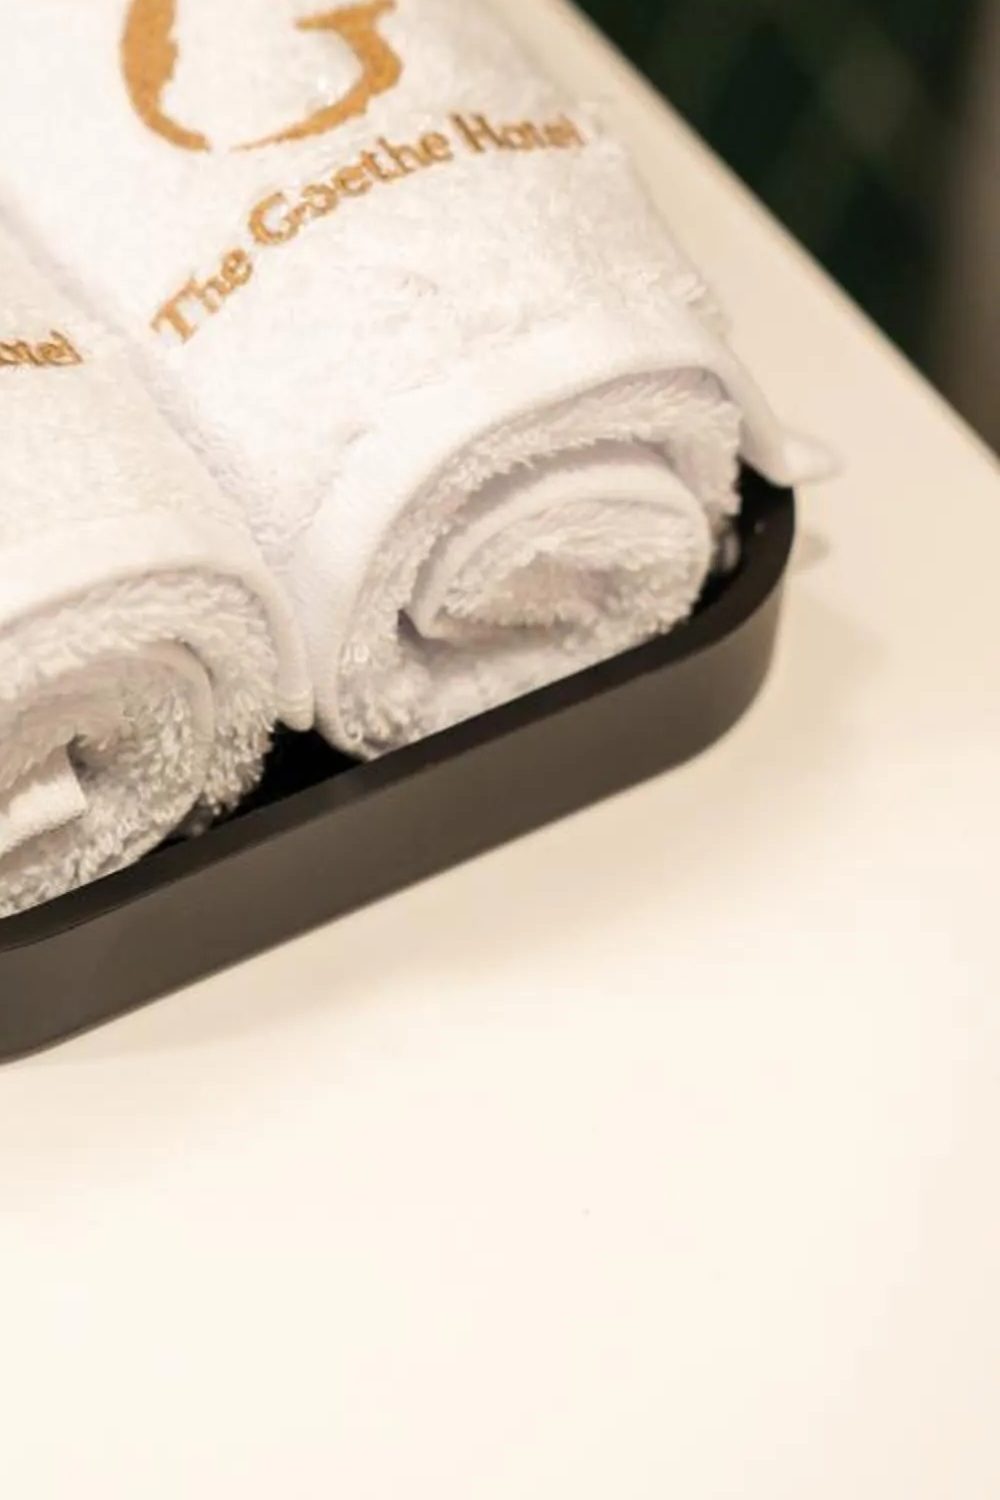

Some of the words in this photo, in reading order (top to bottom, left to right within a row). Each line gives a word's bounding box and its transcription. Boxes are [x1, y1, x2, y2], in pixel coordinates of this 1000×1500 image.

[150, 247, 253, 343] The
[247, 129, 455, 246] Goethe
[450, 112, 589, 154] Hotel
